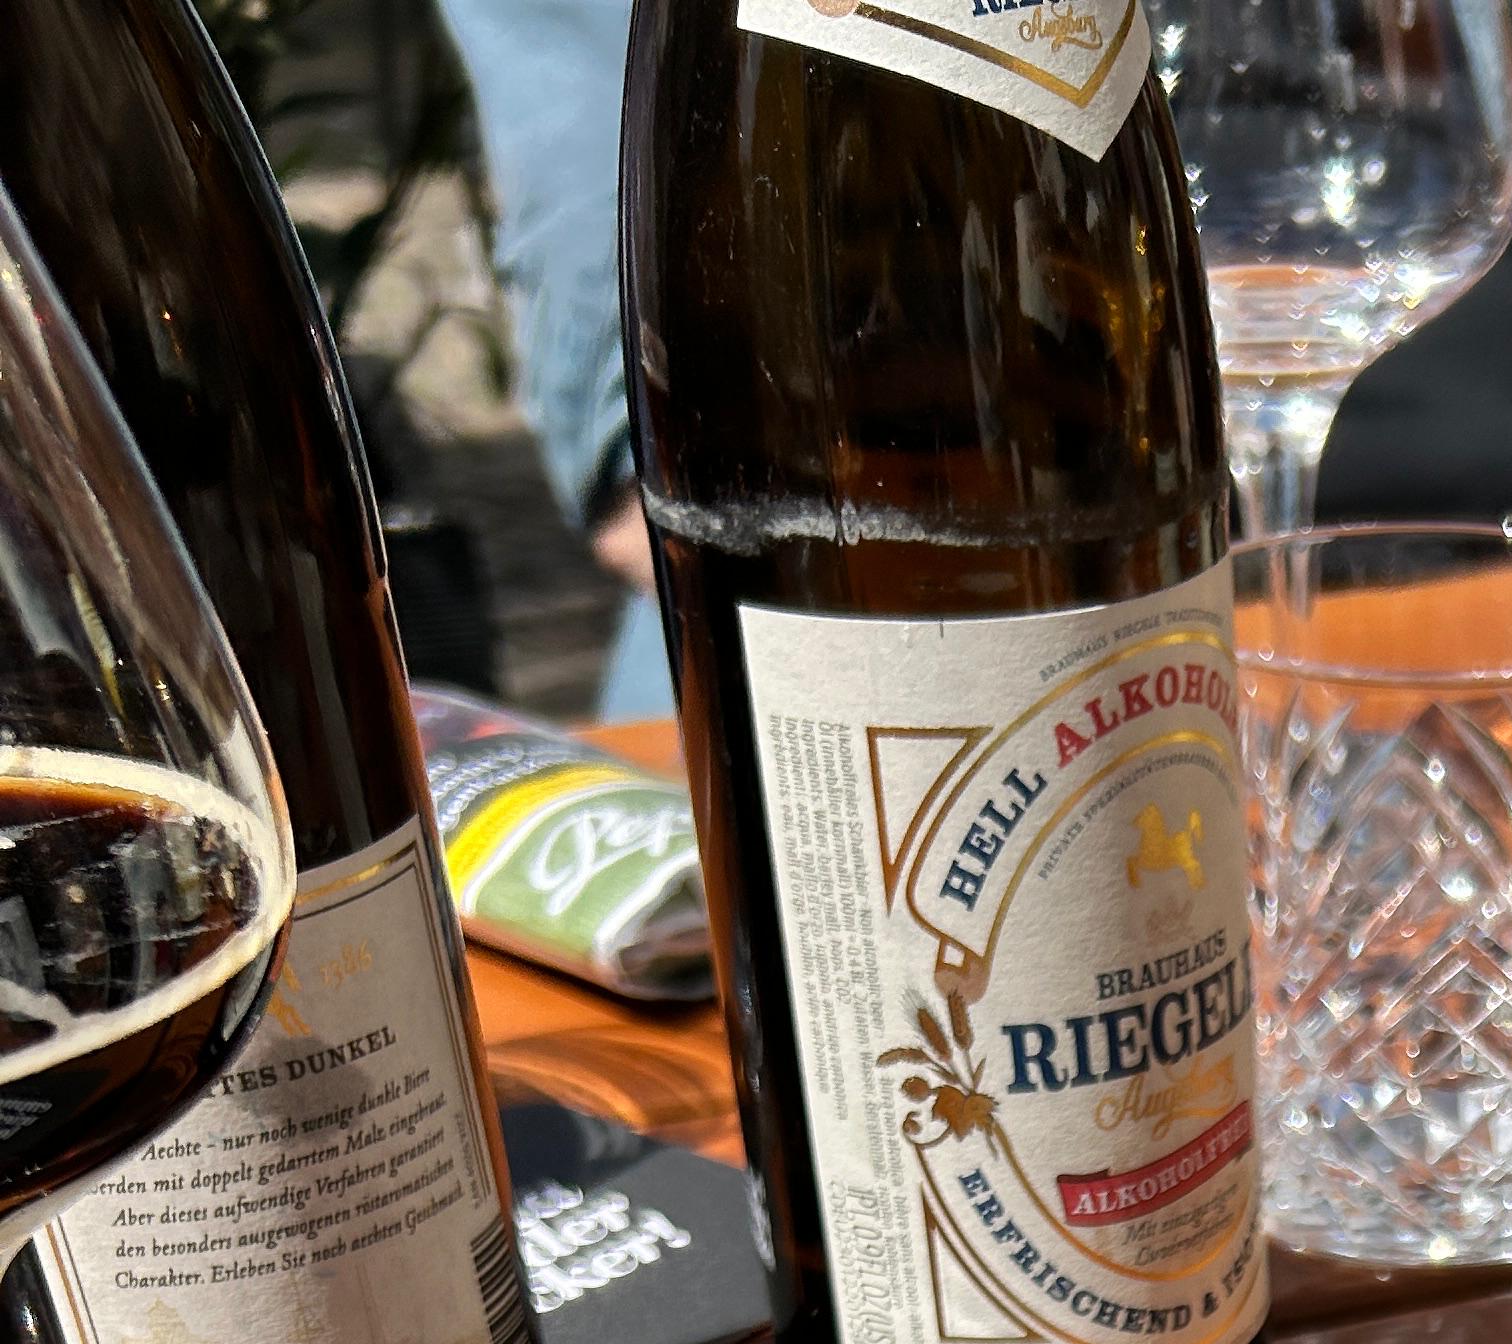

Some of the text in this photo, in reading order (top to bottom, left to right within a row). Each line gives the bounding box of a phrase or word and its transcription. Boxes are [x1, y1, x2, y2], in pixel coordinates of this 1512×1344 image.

[939, 768, 1048, 912] HELL
[1095, 928, 1226, 1001] BRAUHAUS
[286, 1026, 397, 1082] DUNKEL
[141, 1139, 201, 1161] Aechte
[222, 1132, 256, 1152] nur
[259, 1117, 297, 1144] noch
[302, 1102, 354, 1133] wenige
[358, 1080, 401, 1115] dunkle
[112, 1207, 155, 1227] Aber
[160, 1206, 208, 1226] dieses
[214, 1185, 311, 1224] aufwendige
[315, 1161, 386, 1198] Verfahren
[154, 1172, 184, 1192] mit
[190, 1159, 253, 1195] doppelt
[258, 1144, 339, 1186] gedarrtem
[344, 1121, 386, 1155] Malz
[115, 1220, 402, 1290] Charakter. Erleben Sie noch aechten
[116, 1239, 146, 1258] den
[152, 1233, 231, 1256] besonders
[238, 1209, 350, 1249] ausgewogenen
[958, 1167, 1191, 1335] ERFRISCHEND
